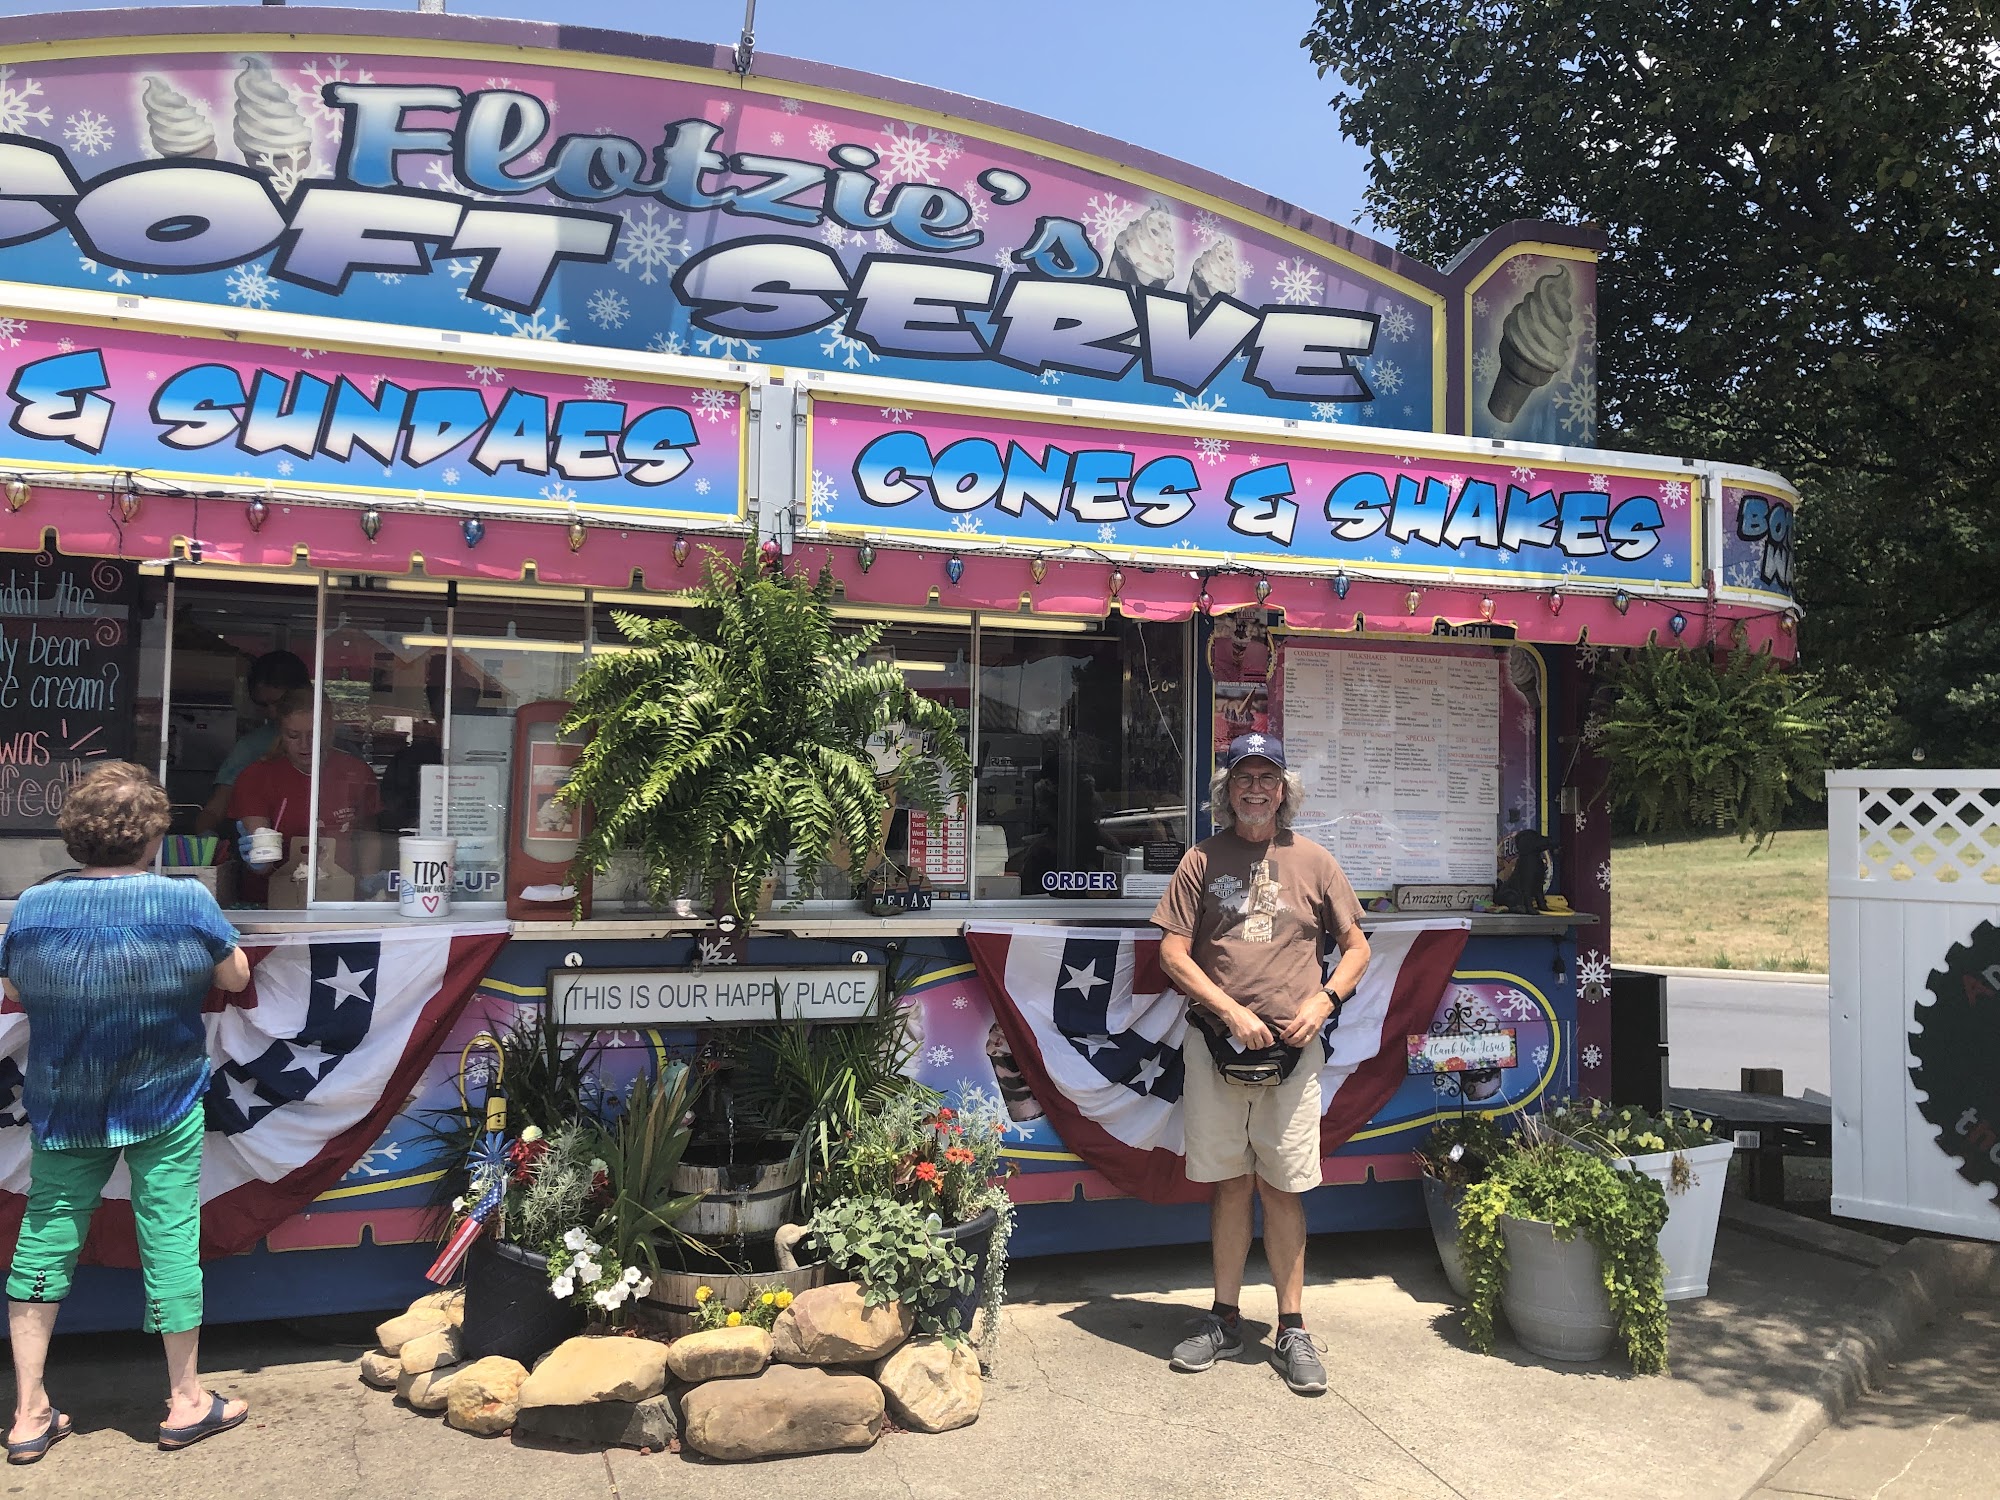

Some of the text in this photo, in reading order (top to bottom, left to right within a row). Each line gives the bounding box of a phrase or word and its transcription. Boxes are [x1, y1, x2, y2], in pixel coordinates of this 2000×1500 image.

[325, 81, 1102, 279] Flotzie's
[672, 236, 1380, 402] SERVE
[6, 349, 699, 486] & SUNDAES
[853, 431, 1665, 561] CONES & SHAKES
[54, 571, 98, 615] the
[29, 623, 90, 667] bear
[0, 662, 119, 711] e cream?
[388, 870, 500, 892] P-UP
[412, 861, 449, 885] TIPS
[1042, 871, 1118, 891] ORDER
[875, 892, 930, 908] RELAX
[1402, 890, 1489, 908] Amazing Grace
[572, 981, 866, 1010] THIS IS OUR HAPPY PLACE
[1479, 1040, 1507, 1056] Jesus
